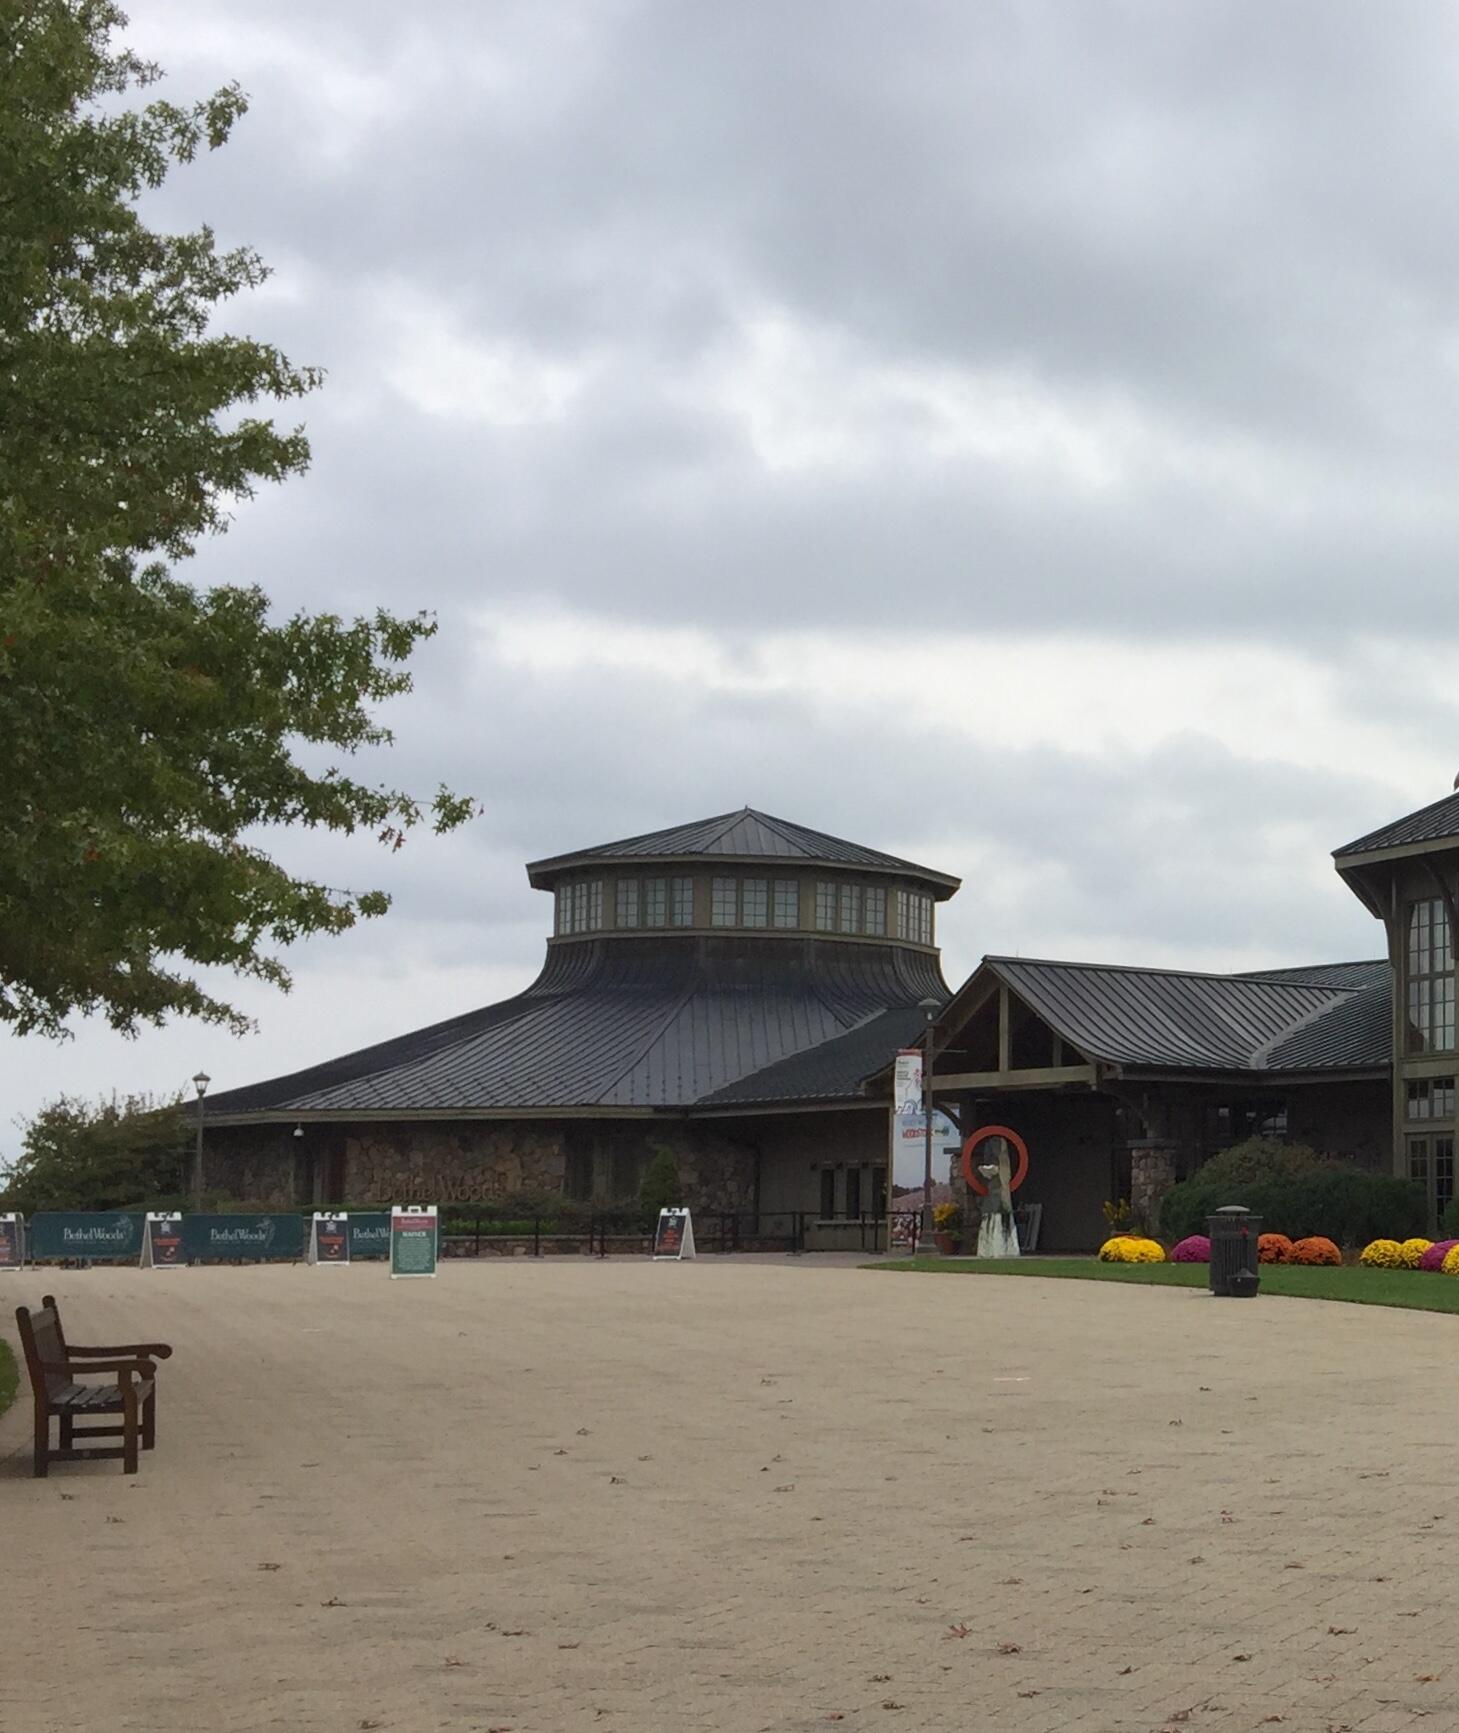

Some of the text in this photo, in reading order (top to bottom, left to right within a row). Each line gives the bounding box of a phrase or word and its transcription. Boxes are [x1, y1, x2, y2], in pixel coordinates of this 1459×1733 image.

[63, 1227, 125, 1241] Bethel Woods
[210, 1228, 237, 1241] Bethel
